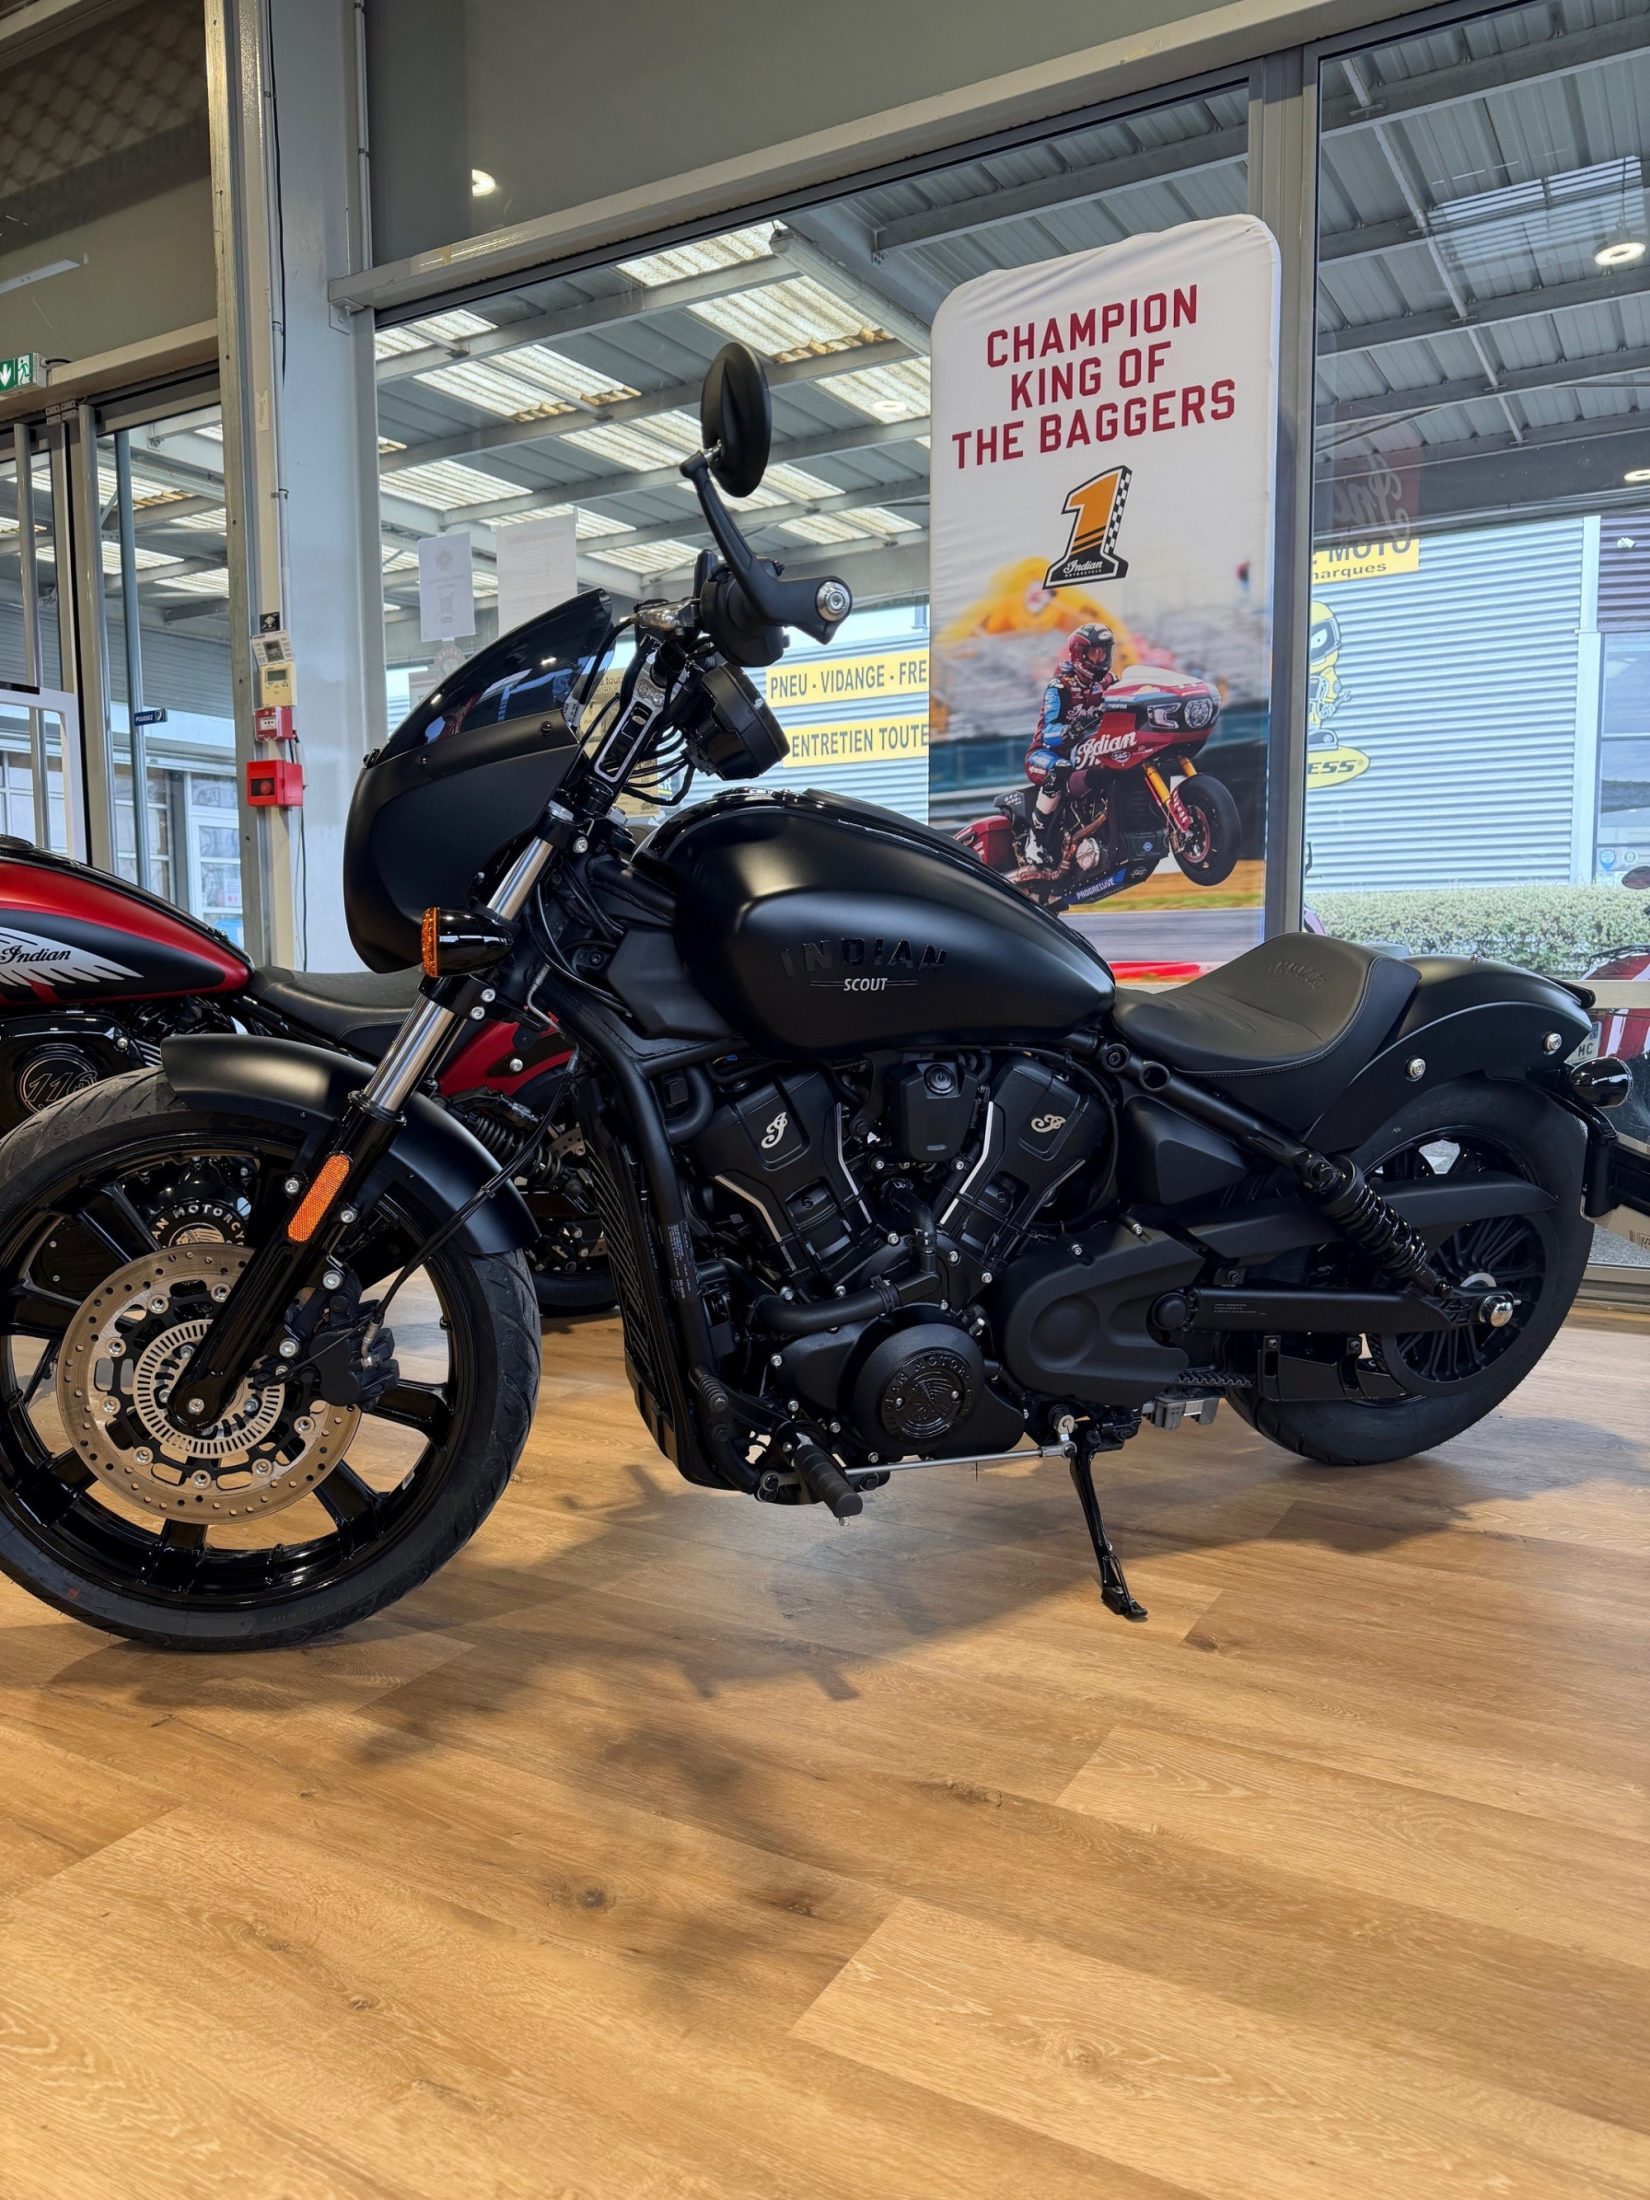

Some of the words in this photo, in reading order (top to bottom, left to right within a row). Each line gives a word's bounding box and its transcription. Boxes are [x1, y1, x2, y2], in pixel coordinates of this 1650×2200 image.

[987, 284, 1198, 368] CHAMPION
[1011, 357, 1101, 411] KING
[1119, 341, 1171, 389] OF
[952, 420, 1024, 469] THE
[1040, 379, 1235, 453] BAGGERS
[1063, 560, 1103, 573] Indian
[771, 674, 807, 699] PNEU
[821, 665, 885, 693] VIDANGE
[899, 660, 927, 685] FRE
[792, 728, 873, 758] ENTRETIEN
[879, 724, 929, 750] TOUTE
[1071, 731, 1137, 770] Idian
[0, 944, 72, 964] Indian
[780, 937, 948, 978] INDIAN
[843, 977, 888, 992] SCOUT
